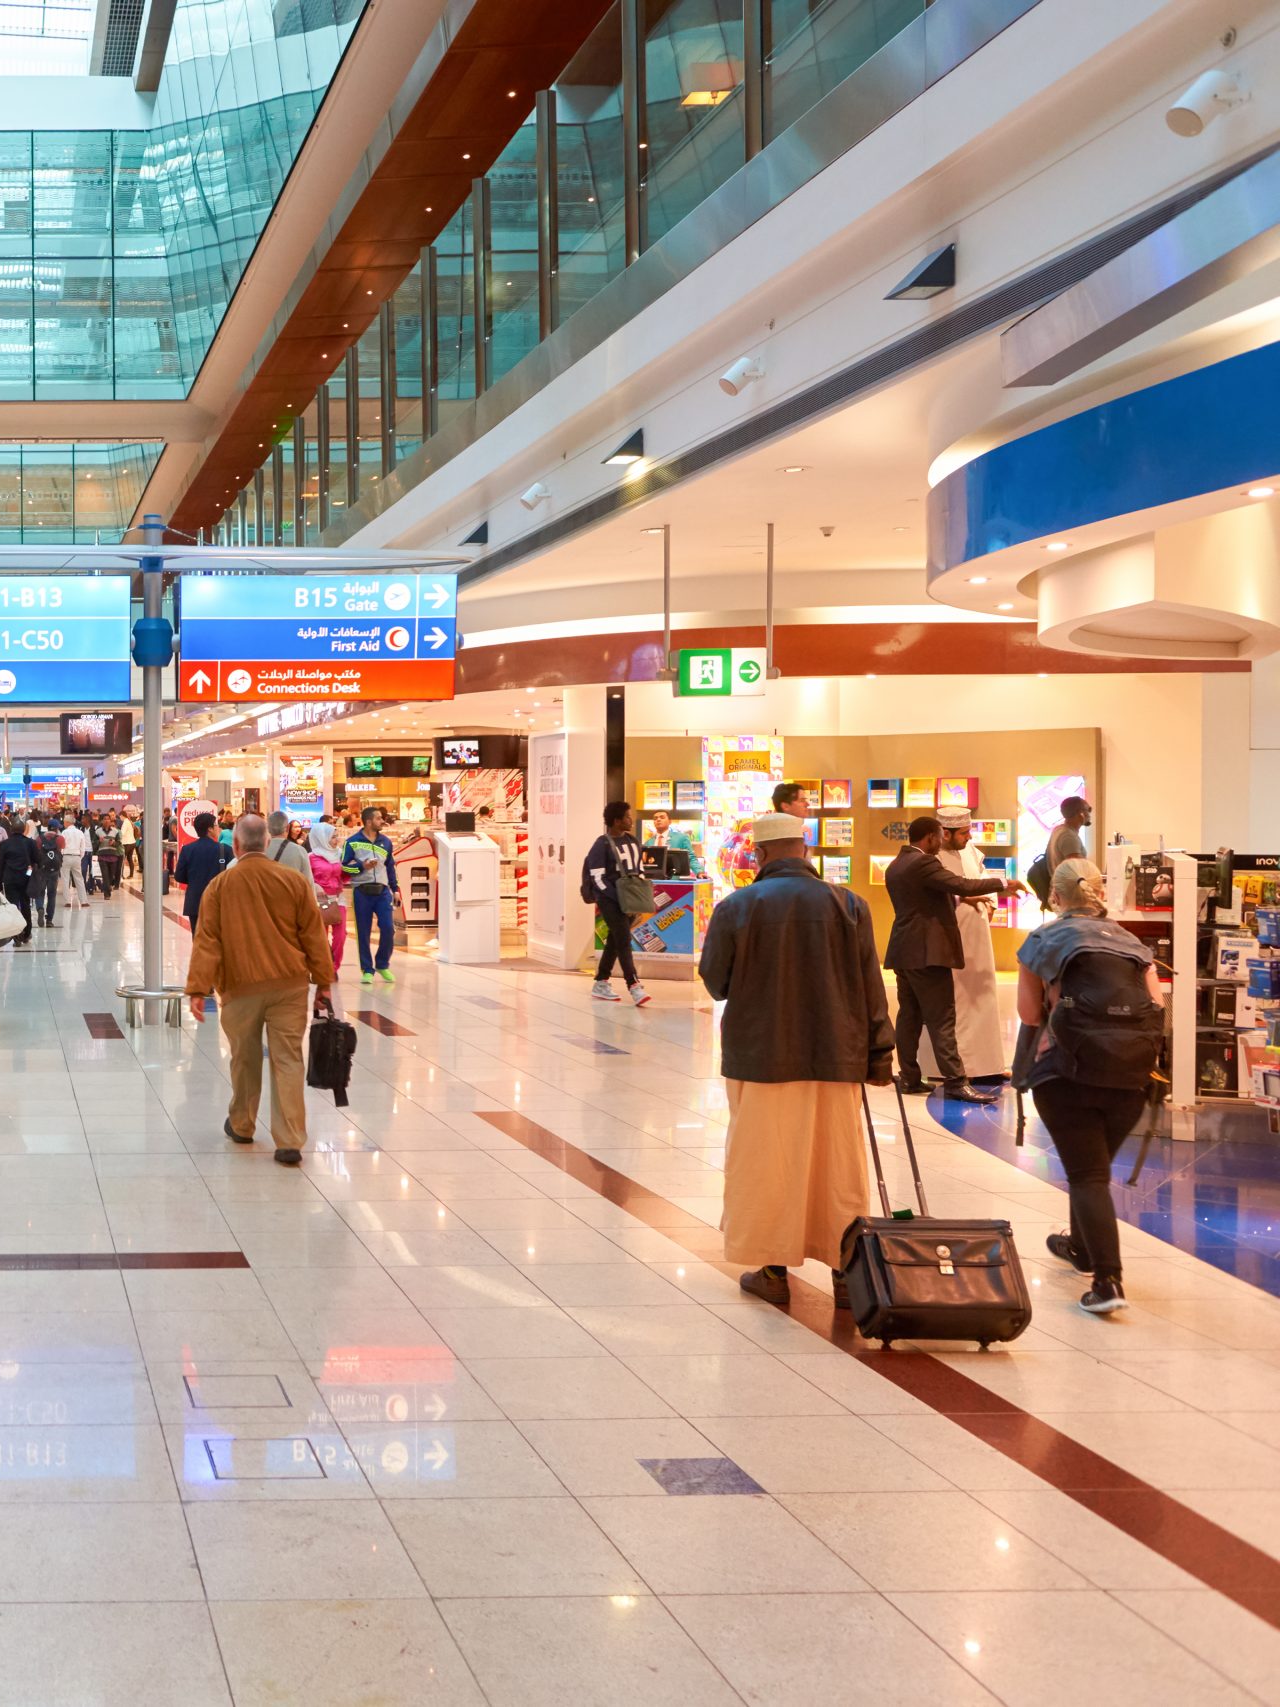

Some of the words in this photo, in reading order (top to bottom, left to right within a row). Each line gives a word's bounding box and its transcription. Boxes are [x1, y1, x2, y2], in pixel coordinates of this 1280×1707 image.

[343, 581, 379, 596] البوابة
[295, 587, 337, 608] B15
[344, 599, 379, 612] Gate
[331, 641, 356, 652] First
[358, 640, 380, 652] Aid
[257, 669, 293, 681] الرحلات
[295, 669, 332, 681] مواصلة
[333, 669, 361, 681] مكتب
[257, 682, 330, 694] Connections
[332, 681, 361, 693] Desk
